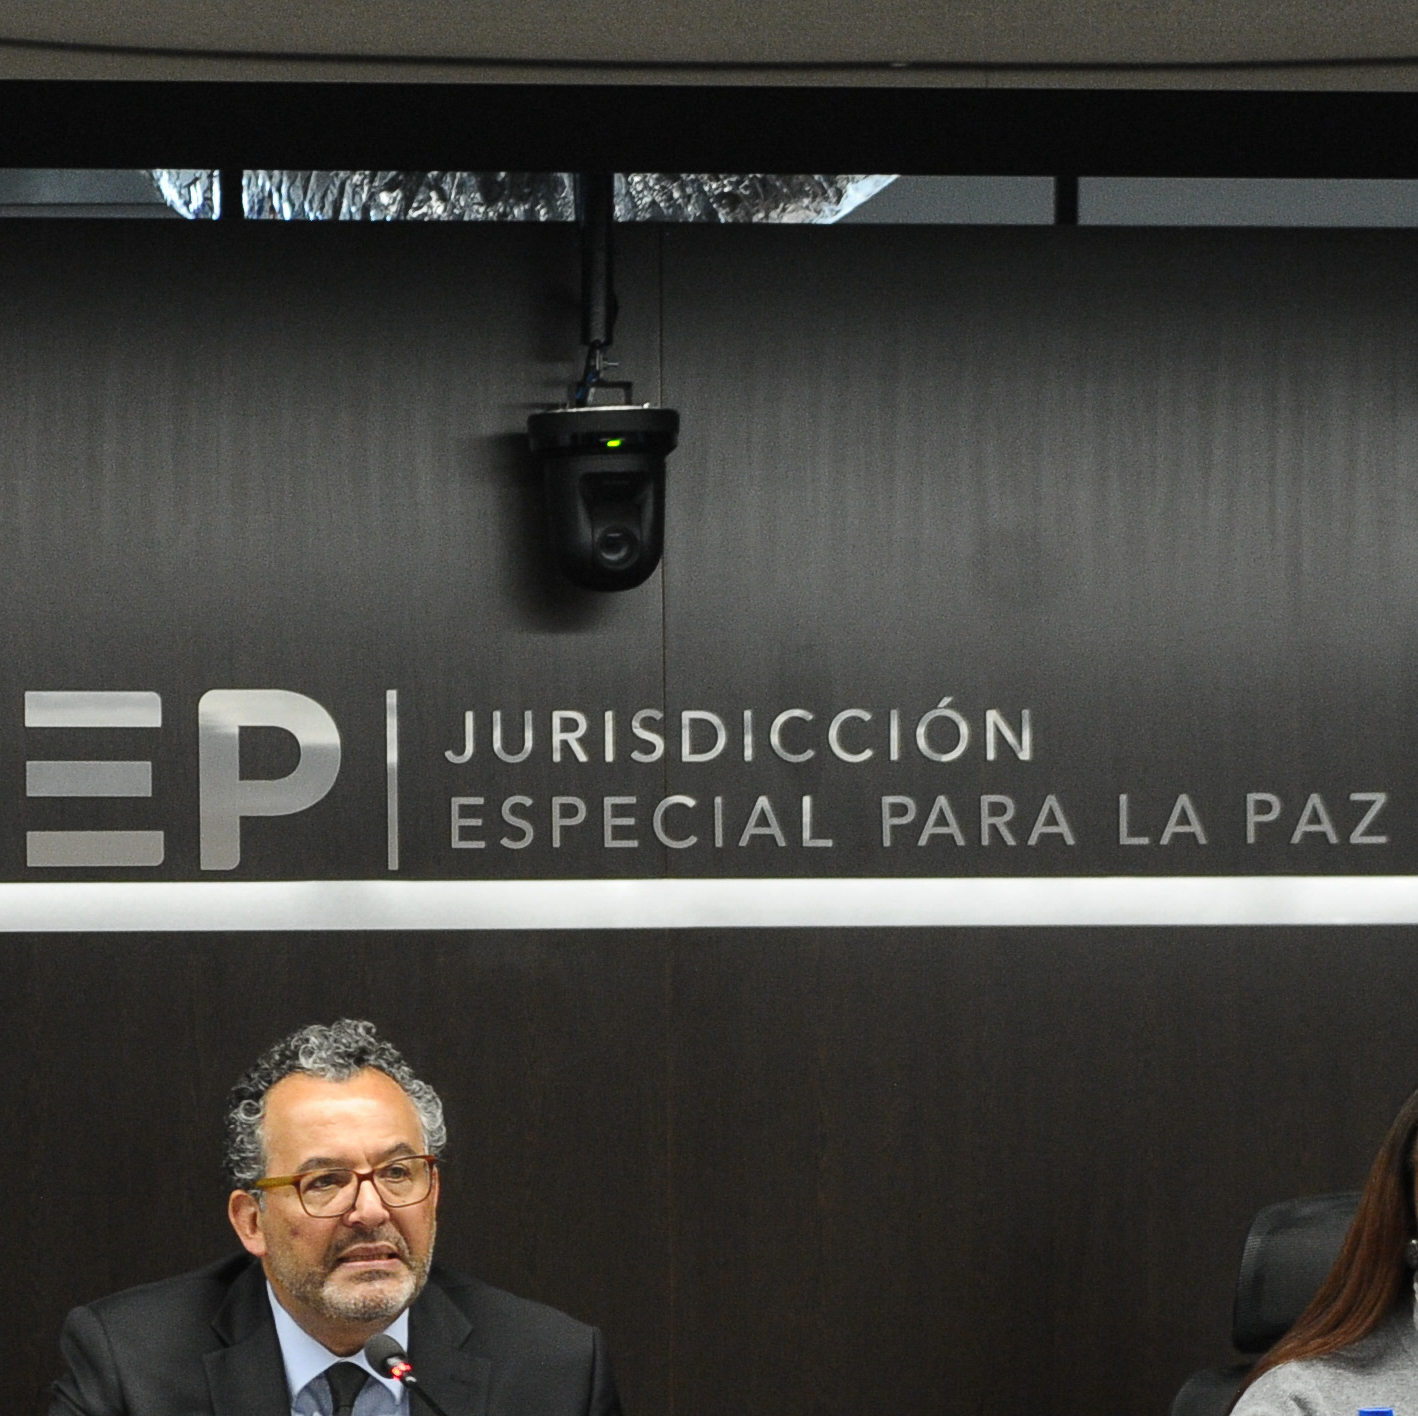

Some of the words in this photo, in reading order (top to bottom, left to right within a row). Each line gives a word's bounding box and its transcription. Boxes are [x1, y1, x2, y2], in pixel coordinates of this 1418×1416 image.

[444, 696, 1033, 764] JURISDICCIÓN
[450, 794, 833, 849] ESPECIAL
[881, 794, 1076, 847] PARA
[1118, 793, 1208, 845] LA
[1245, 791, 1389, 845] PAZ
